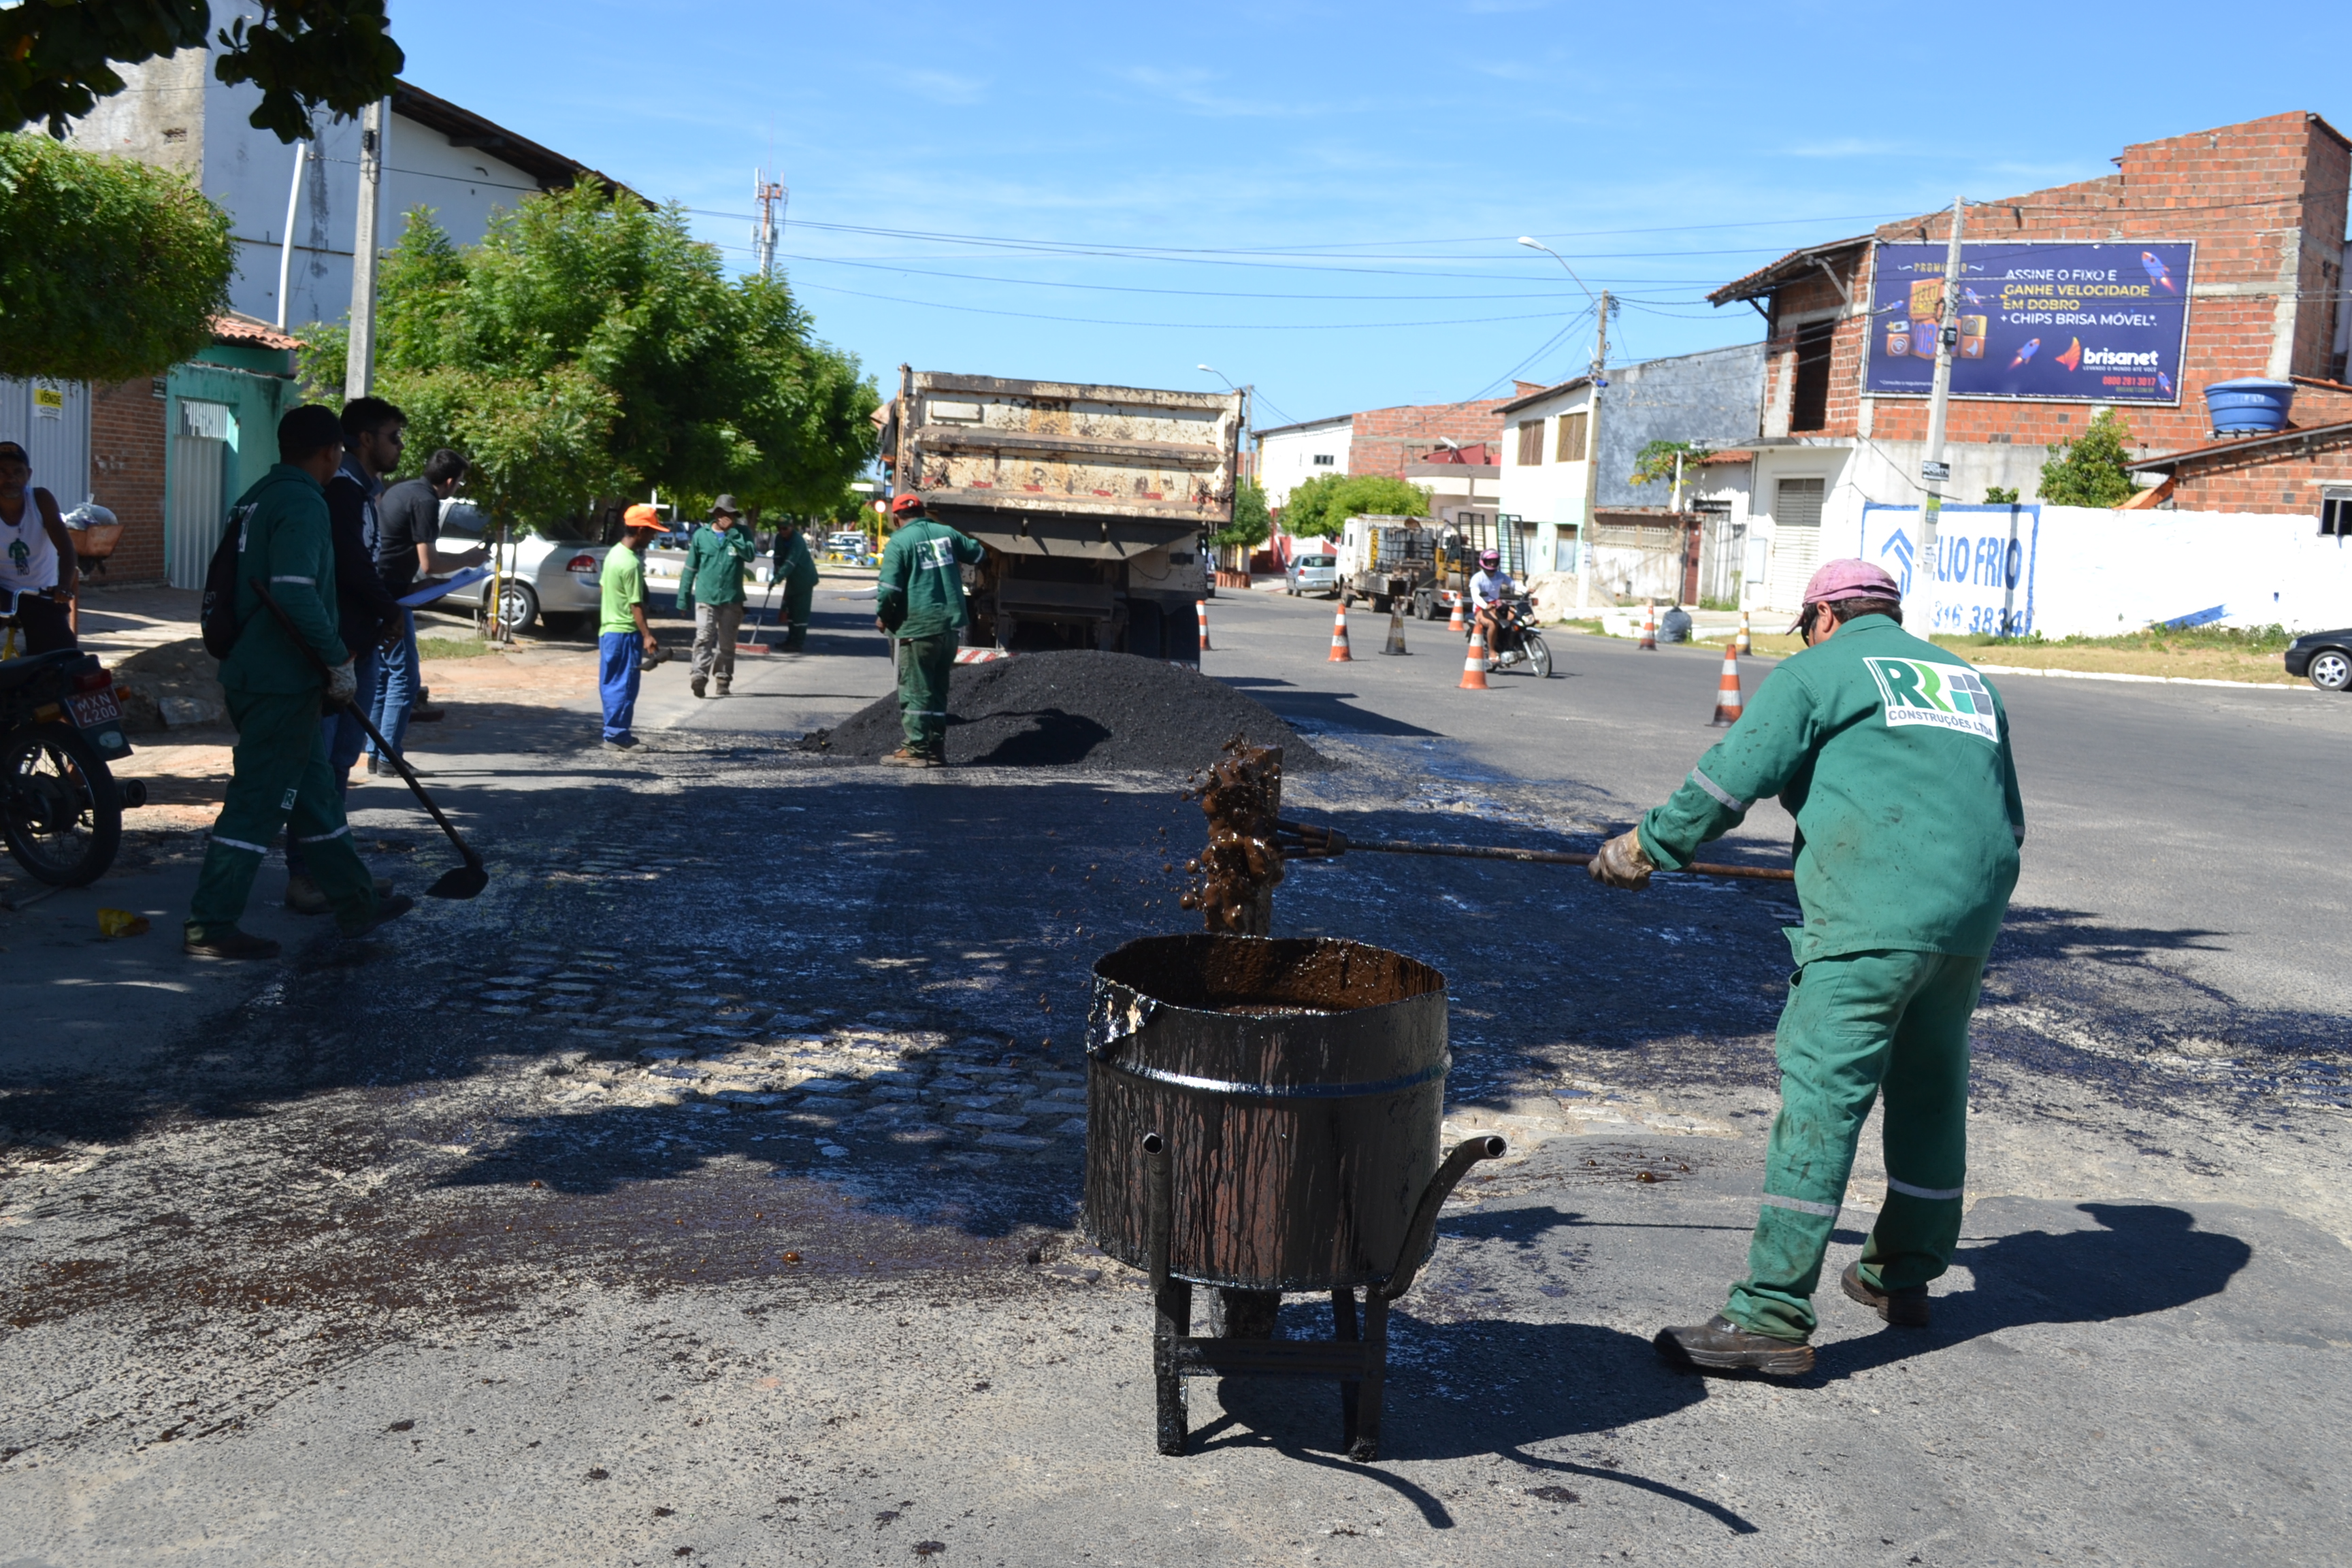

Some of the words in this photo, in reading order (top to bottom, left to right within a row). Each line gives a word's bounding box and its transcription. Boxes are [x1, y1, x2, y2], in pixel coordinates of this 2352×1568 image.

[2007, 270, 2055, 281] ASSINE
[2057, 270, 2070, 281] O
[2073, 270, 2105, 282] FIXO
[2108, 270, 2117, 281] E
[2004, 284, 2054, 295] GANHE
[2057, 284, 2151, 296] VELOCIDADE
[2003, 299, 2024, 310] EM
[2027, 299, 2080, 310] DOBRO
[2010, 312, 2053, 325] CHIPS
[2055, 313, 2097, 325] BRISA
[2083, 347, 2159, 365] brisanet
[2102, 376, 2121, 385] 0800
[1974, 537, 2023, 590] FRIO
[1969, 605, 2023, 638] 3834
[77, 693, 111, 712] MXN
[84, 705, 118, 723] 4200
[1889, 710, 1972, 730] CONSTRUÇÕES
[1974, 721, 1995, 738] LTDA
